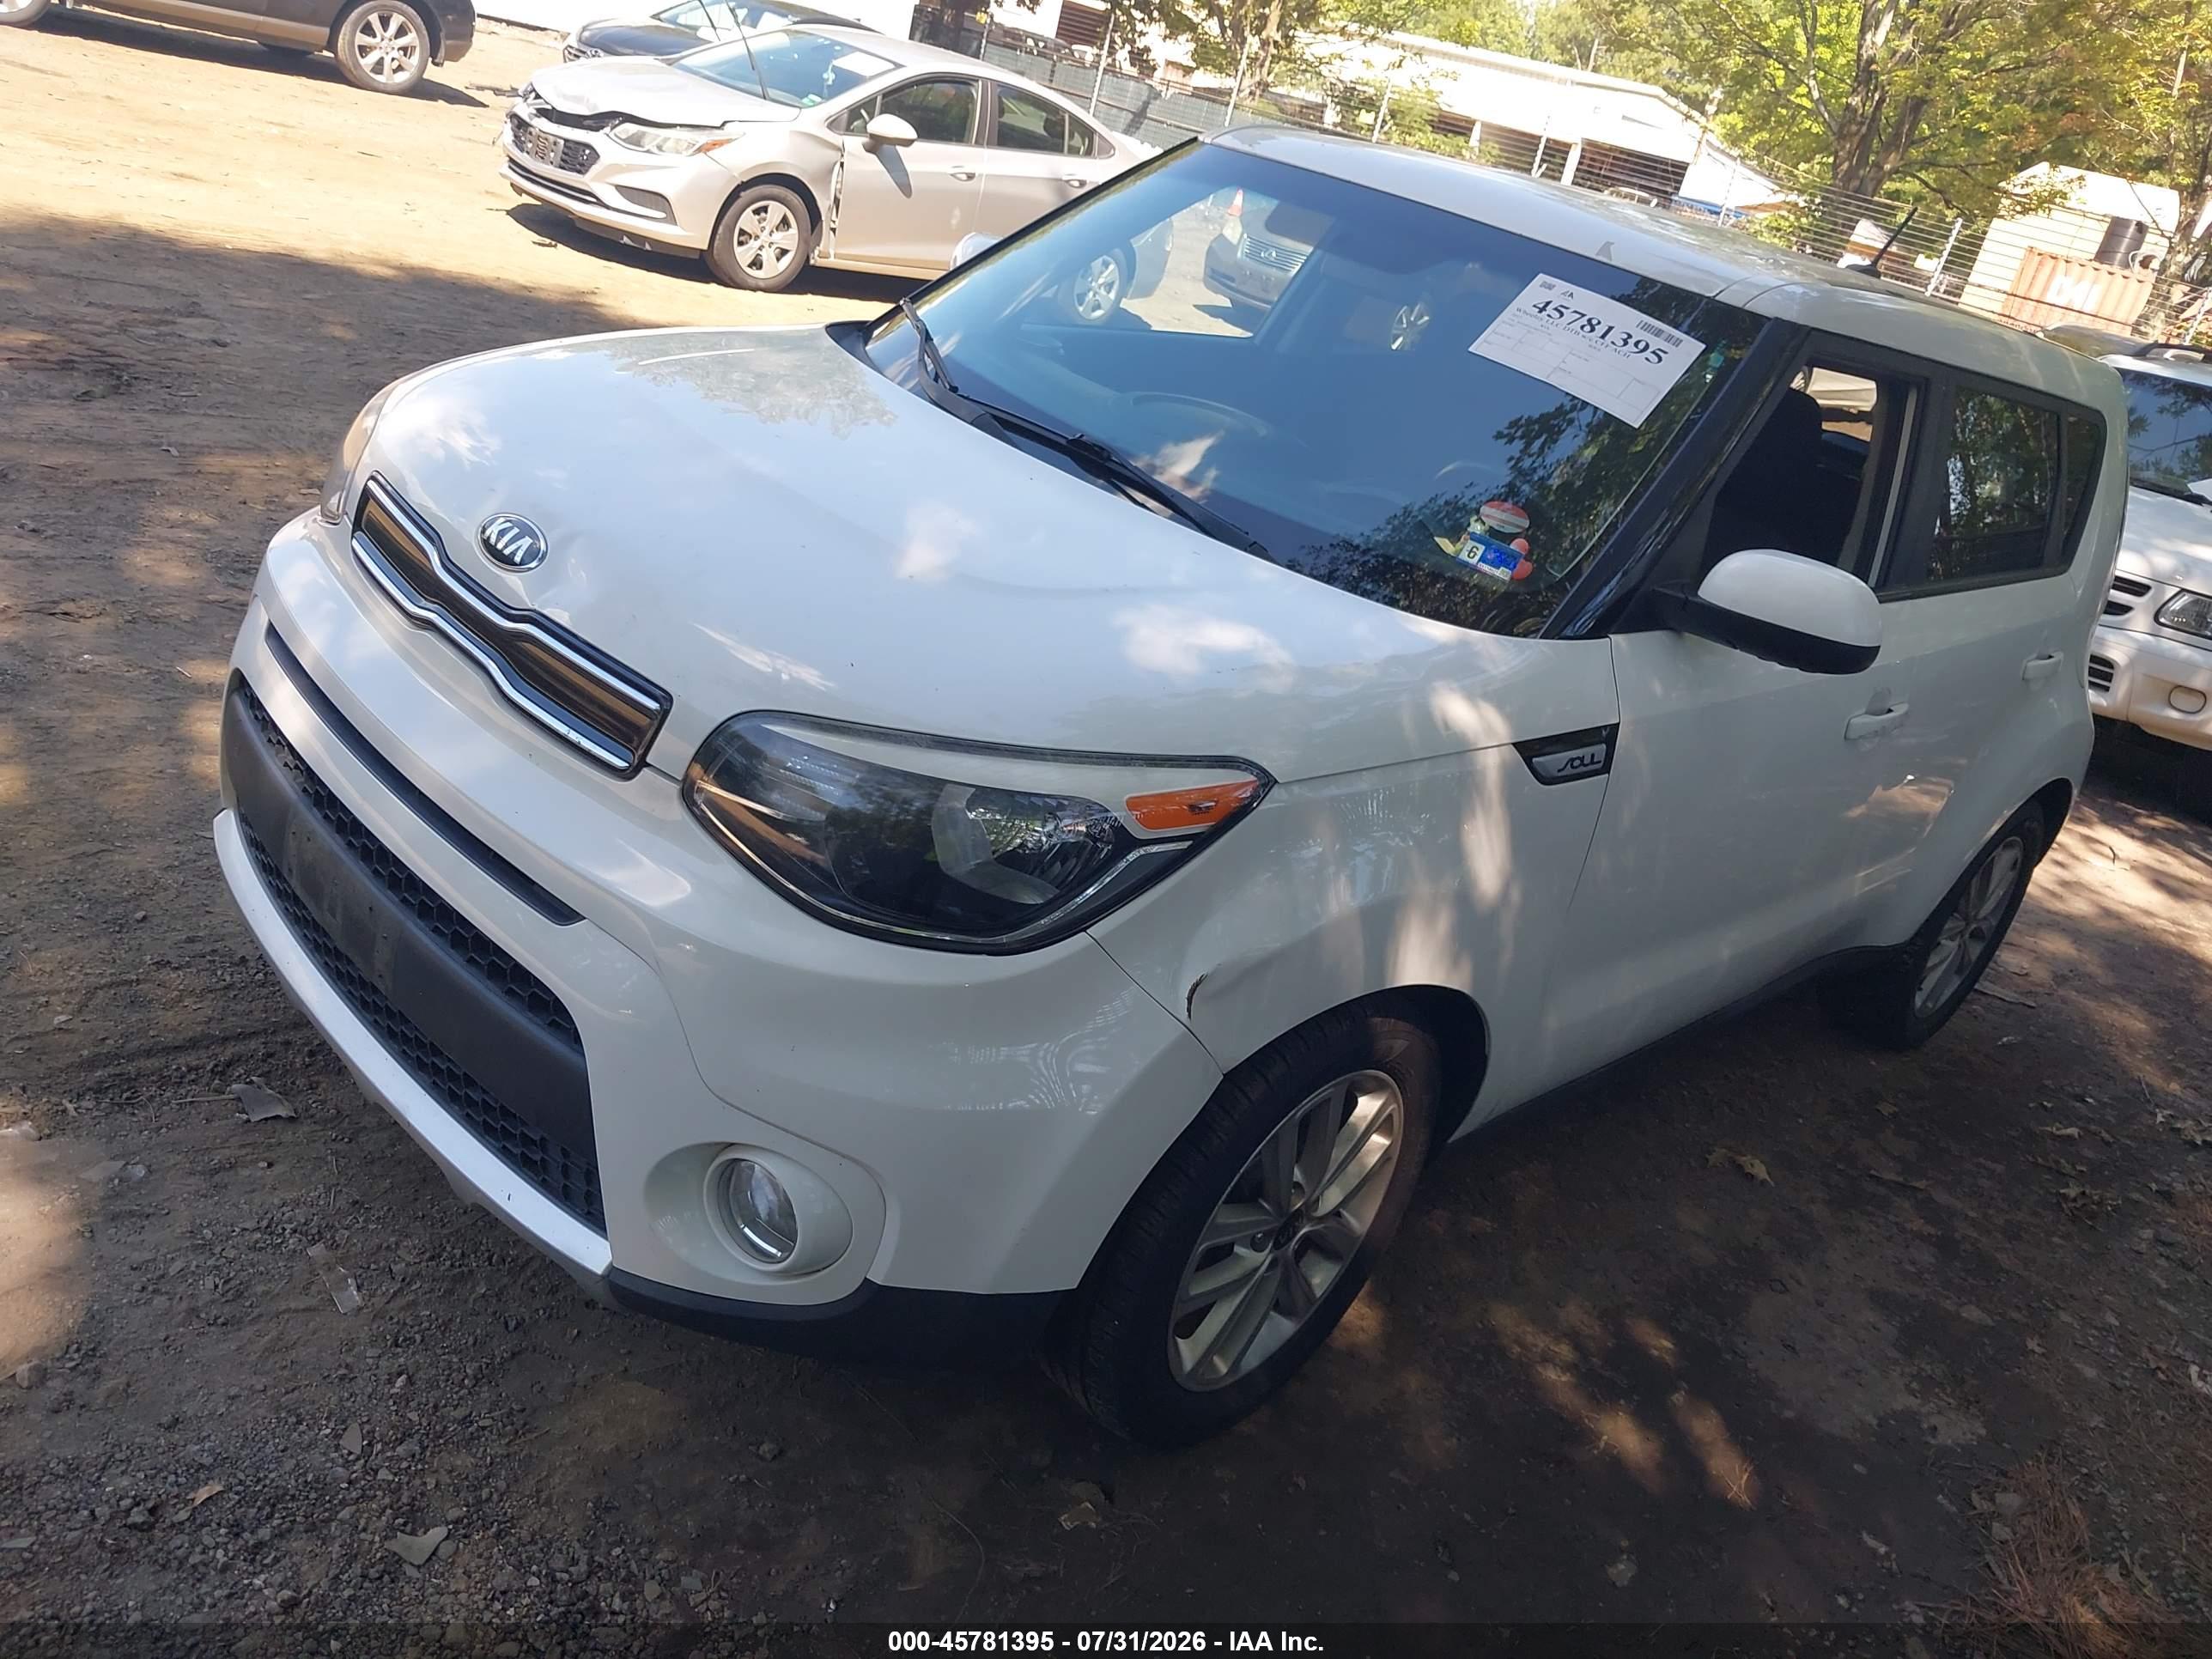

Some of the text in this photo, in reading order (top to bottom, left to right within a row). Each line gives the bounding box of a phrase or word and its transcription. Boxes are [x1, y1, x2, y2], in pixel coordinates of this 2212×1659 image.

[1532, 300, 1669, 365] 45781395
[483, 517, 533, 565] KIA
[1467, 545, 1479, 559] 6
[1557, 753, 1601, 773] SOUL
